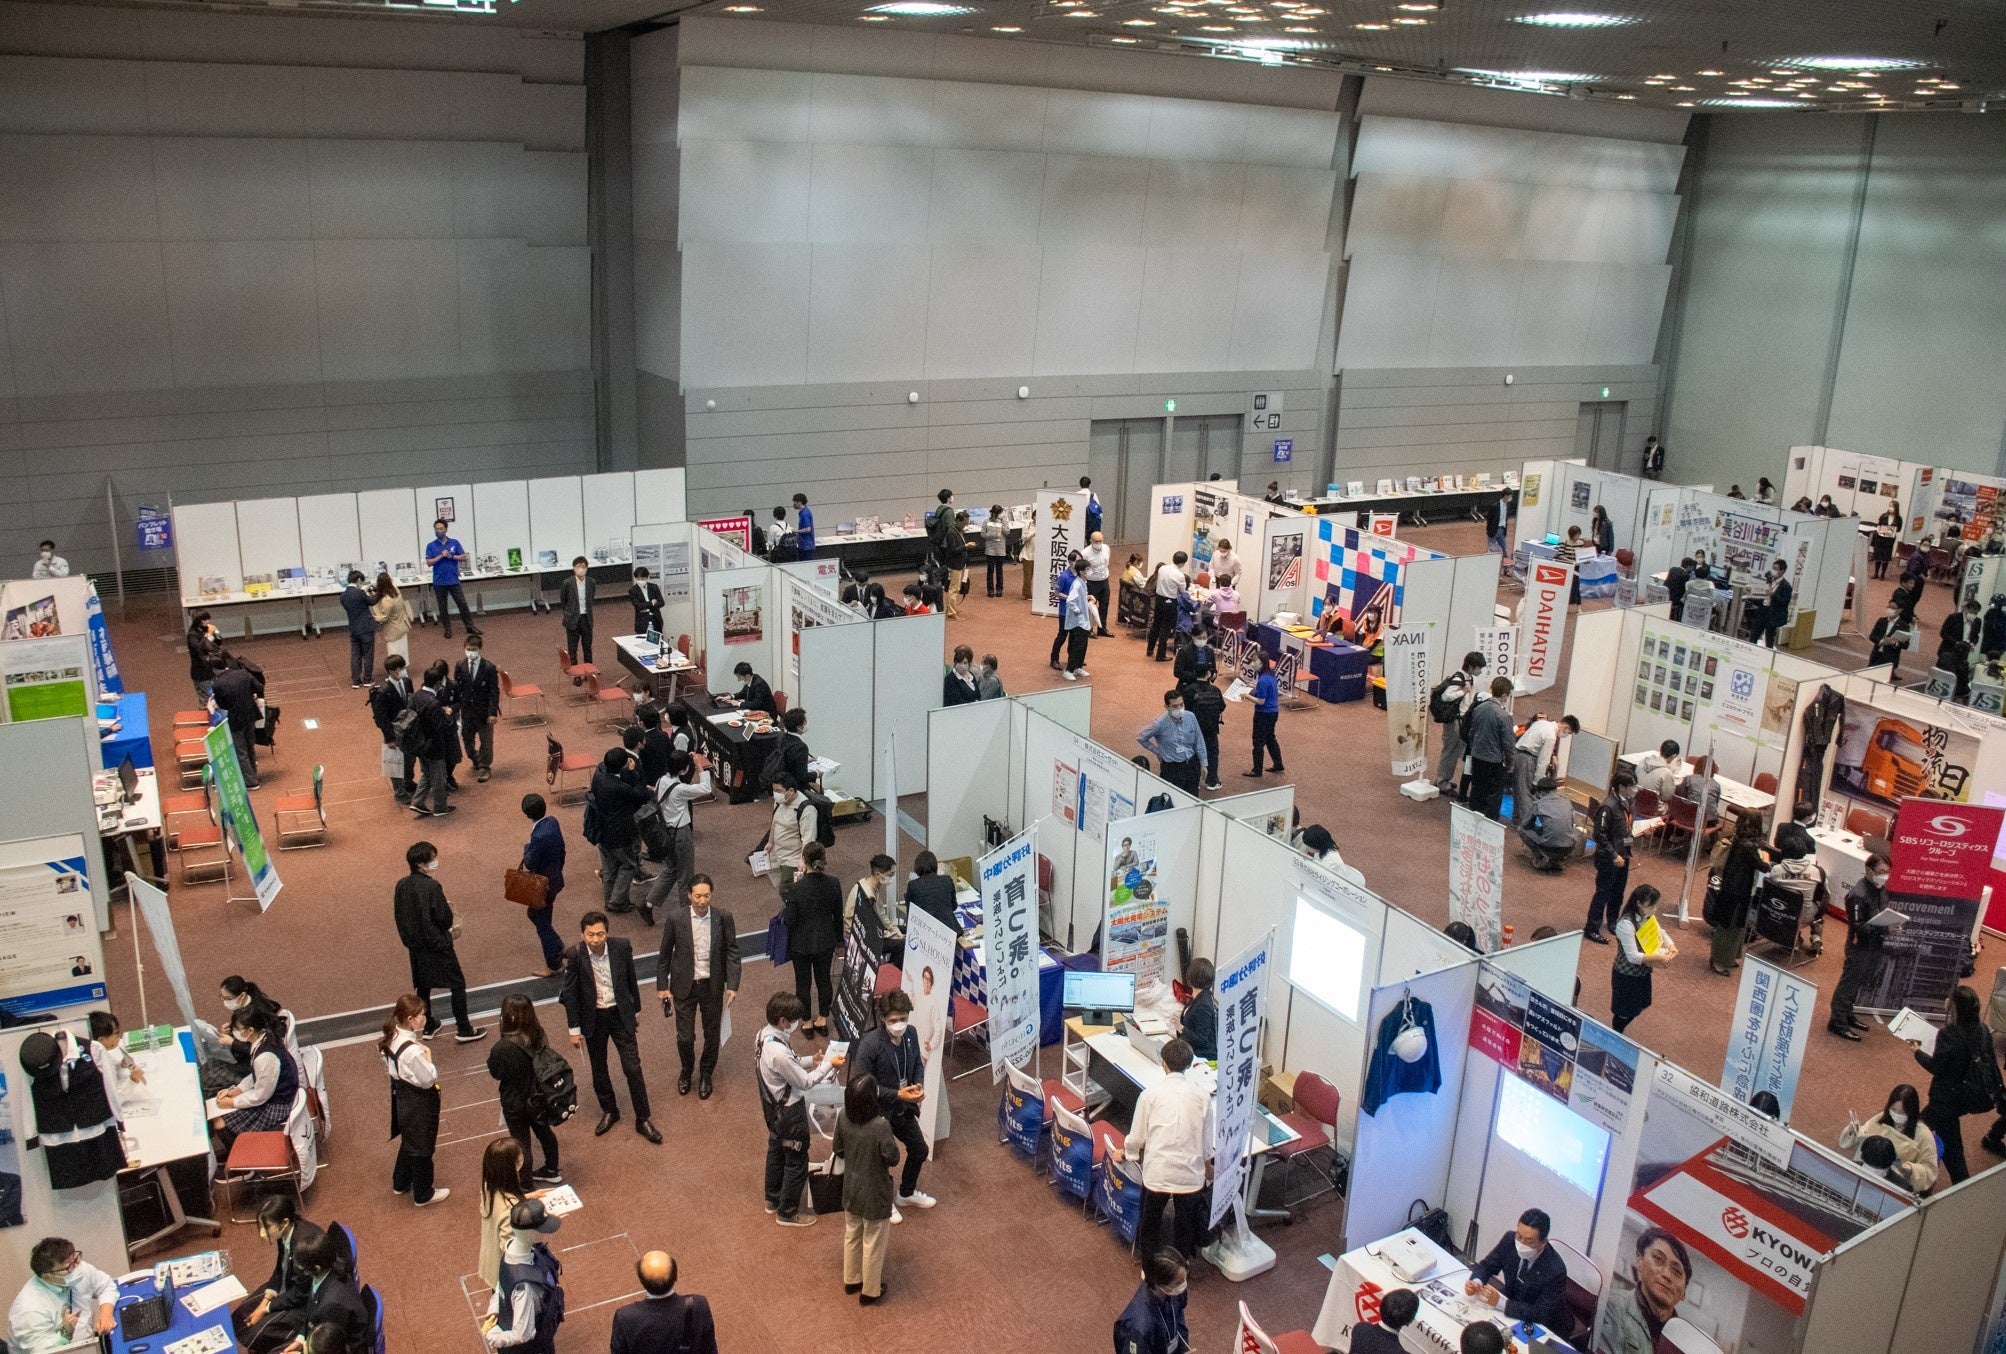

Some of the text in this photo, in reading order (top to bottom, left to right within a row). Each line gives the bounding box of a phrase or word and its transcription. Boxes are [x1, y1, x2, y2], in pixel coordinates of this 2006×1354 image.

[1527, 589, 1557, 678] DAIHATSU
[1900, 836, 1988, 852] SBS リコーロジスティクス
[1928, 847, 1956, 856] グループ
[1661, 1070, 1673, 1082] 32
[1690, 1085, 1769, 1138] 協和道路株式会社
[1416, 1320, 1462, 1354] KYOW
